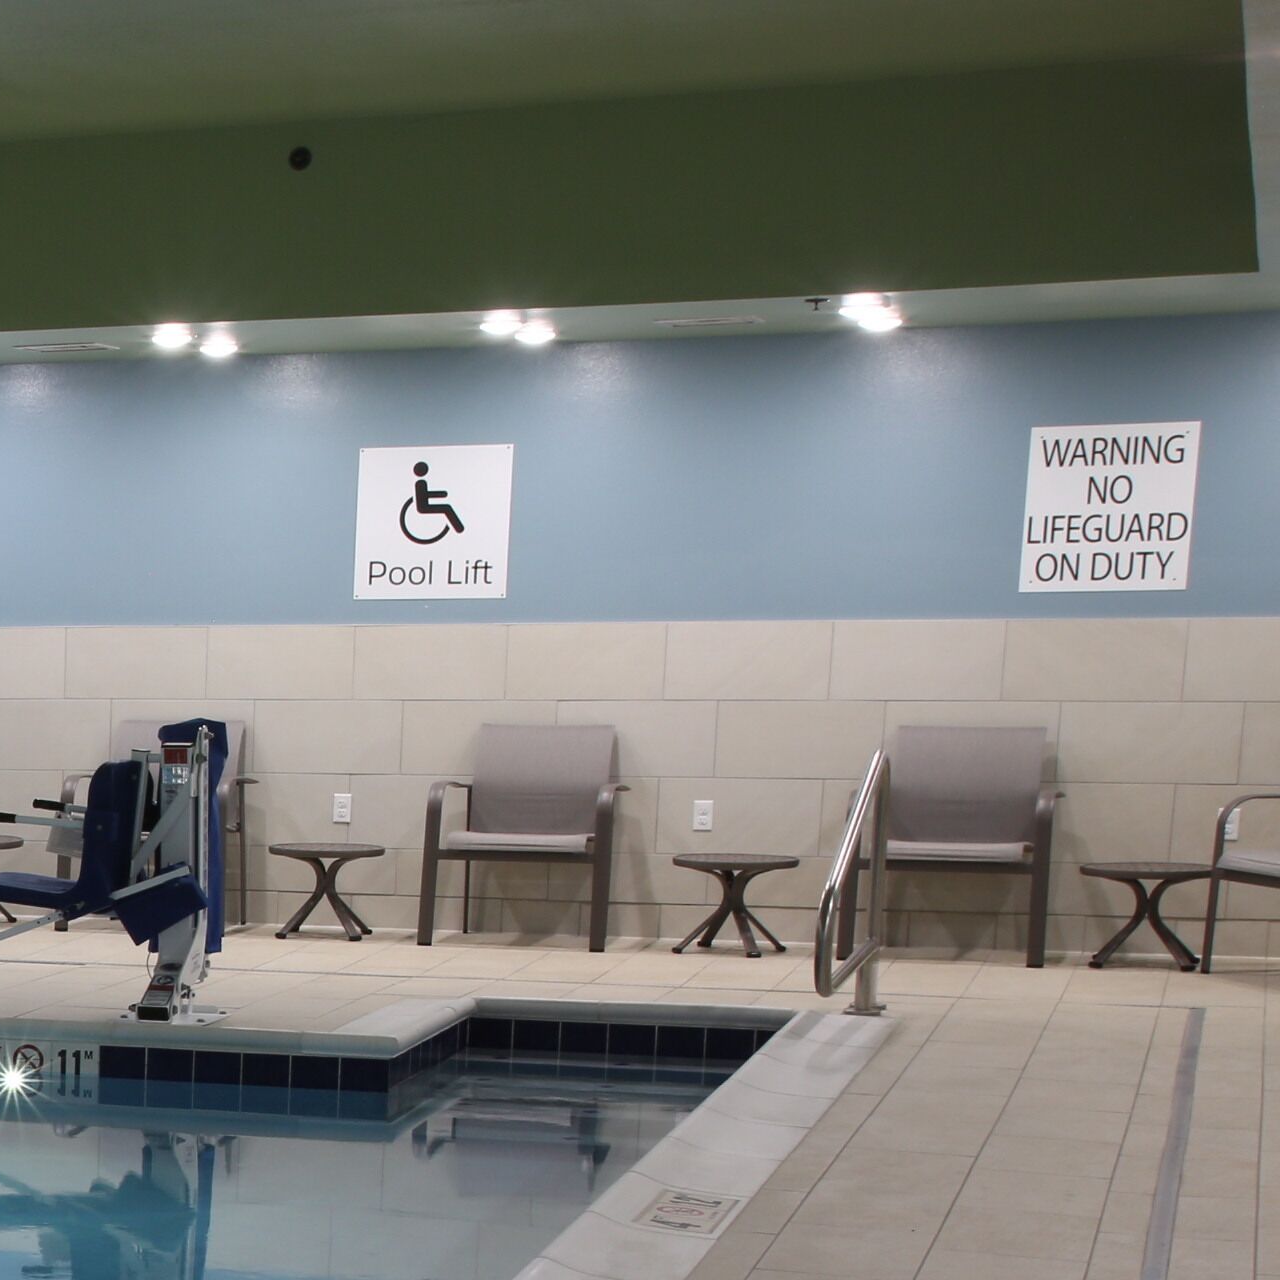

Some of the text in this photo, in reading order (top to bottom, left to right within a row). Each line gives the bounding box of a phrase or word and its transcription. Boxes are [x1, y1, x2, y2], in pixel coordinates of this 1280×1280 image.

[1042, 435, 1186, 467] WARNING
[1087, 475, 1133, 504] NO
[1027, 512, 1189, 544] LIFEGUARD
[368, 559, 493, 586] Pool Lift
[1035, 551, 1175, 582] ON DUTY
[84, 1050, 93, 1060] M
